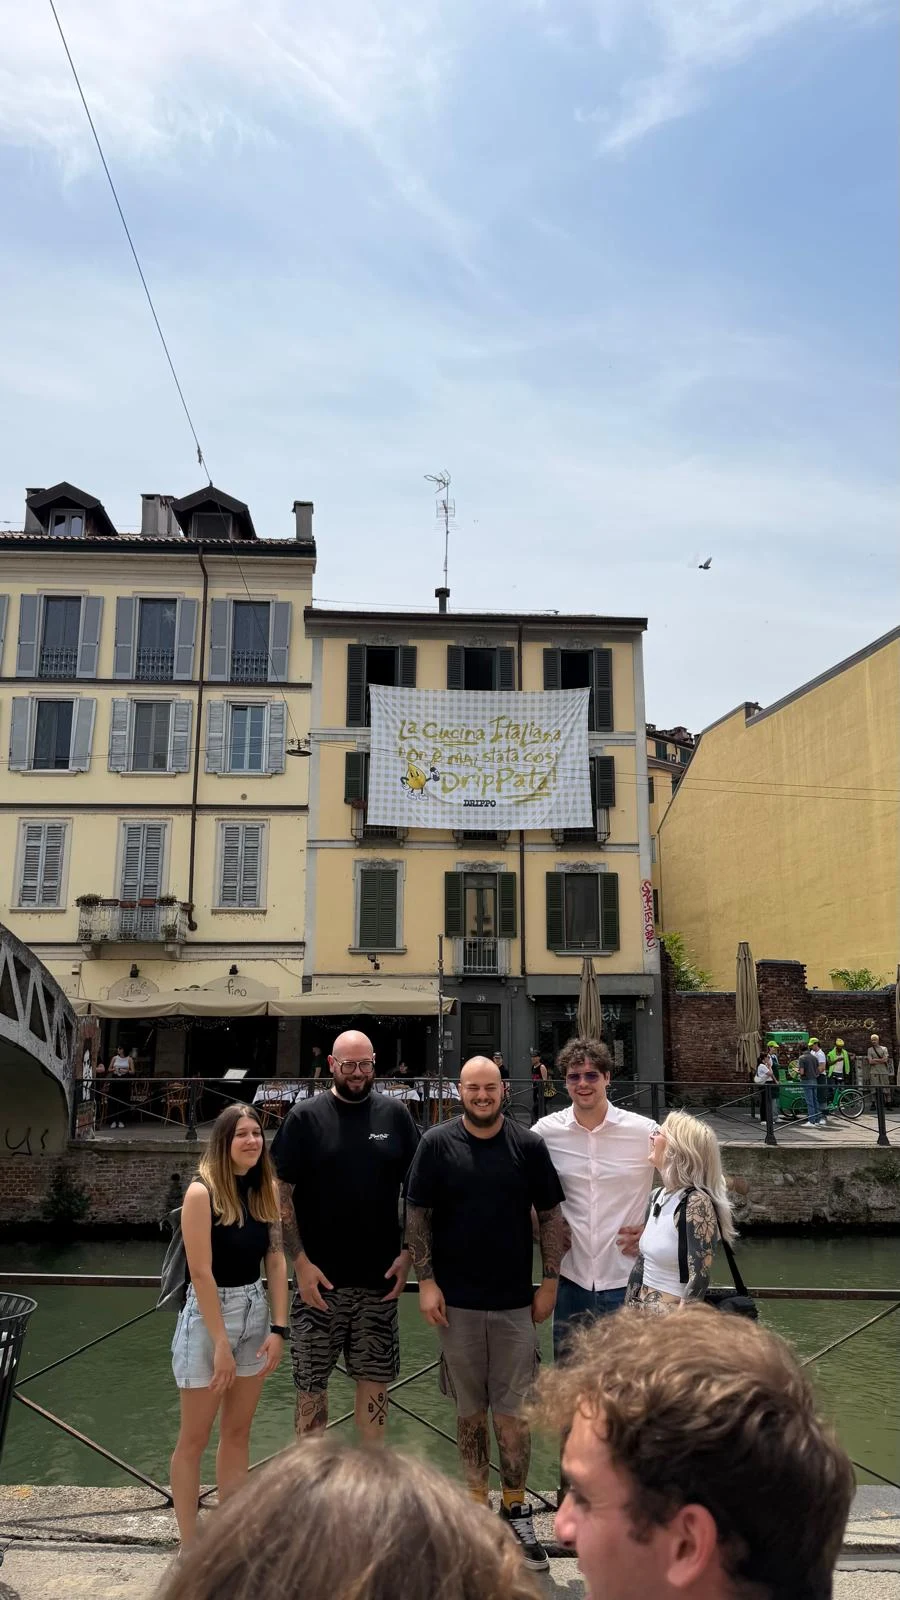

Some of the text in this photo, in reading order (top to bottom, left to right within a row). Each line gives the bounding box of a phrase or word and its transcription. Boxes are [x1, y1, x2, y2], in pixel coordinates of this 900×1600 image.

[398, 715, 561, 747] La Cucina Italiana
[482, 746, 519, 762] stata
[463, 799, 496, 807] DRIPPO
